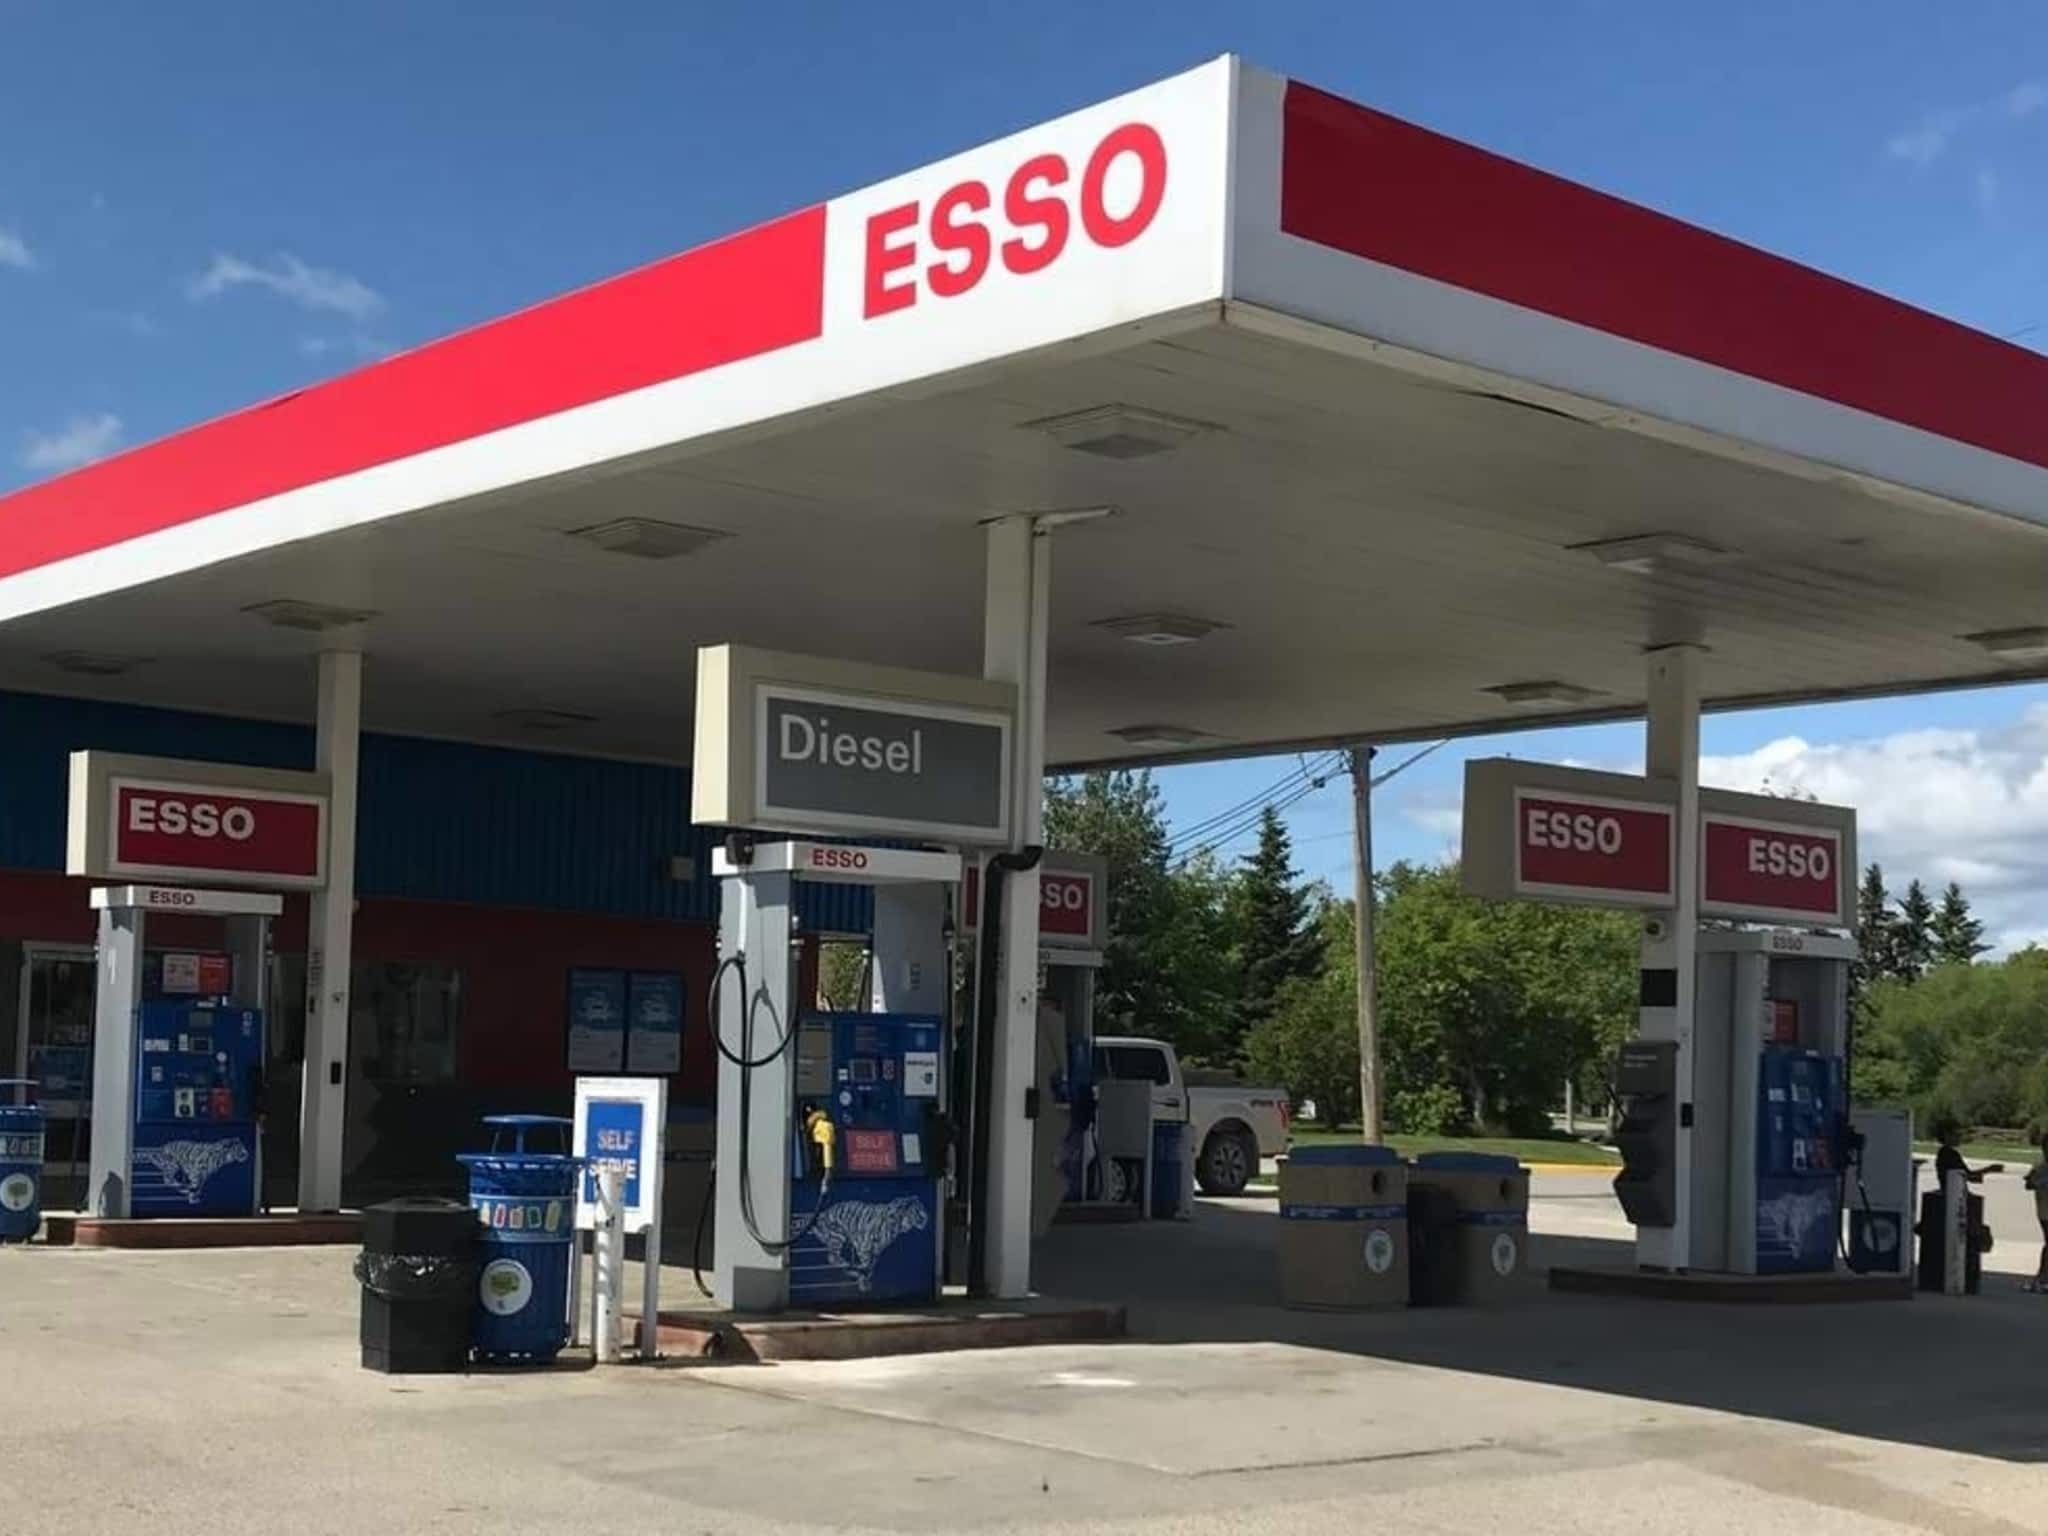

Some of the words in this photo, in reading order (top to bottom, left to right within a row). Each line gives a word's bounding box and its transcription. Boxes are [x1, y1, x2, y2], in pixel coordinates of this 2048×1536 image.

[863, 122, 1167, 320] ESSO
[780, 713, 922, 774] Diesel
[128, 798, 255, 840] ESSO
[1527, 809, 1622, 854] ESSO
[811, 848, 868, 868] ESSO
[1748, 838, 1831, 881] ESSO
[150, 890, 196, 905] ESSO
[1040, 882, 1083, 910] SO
[597, 1129, 635, 1151] SELF
